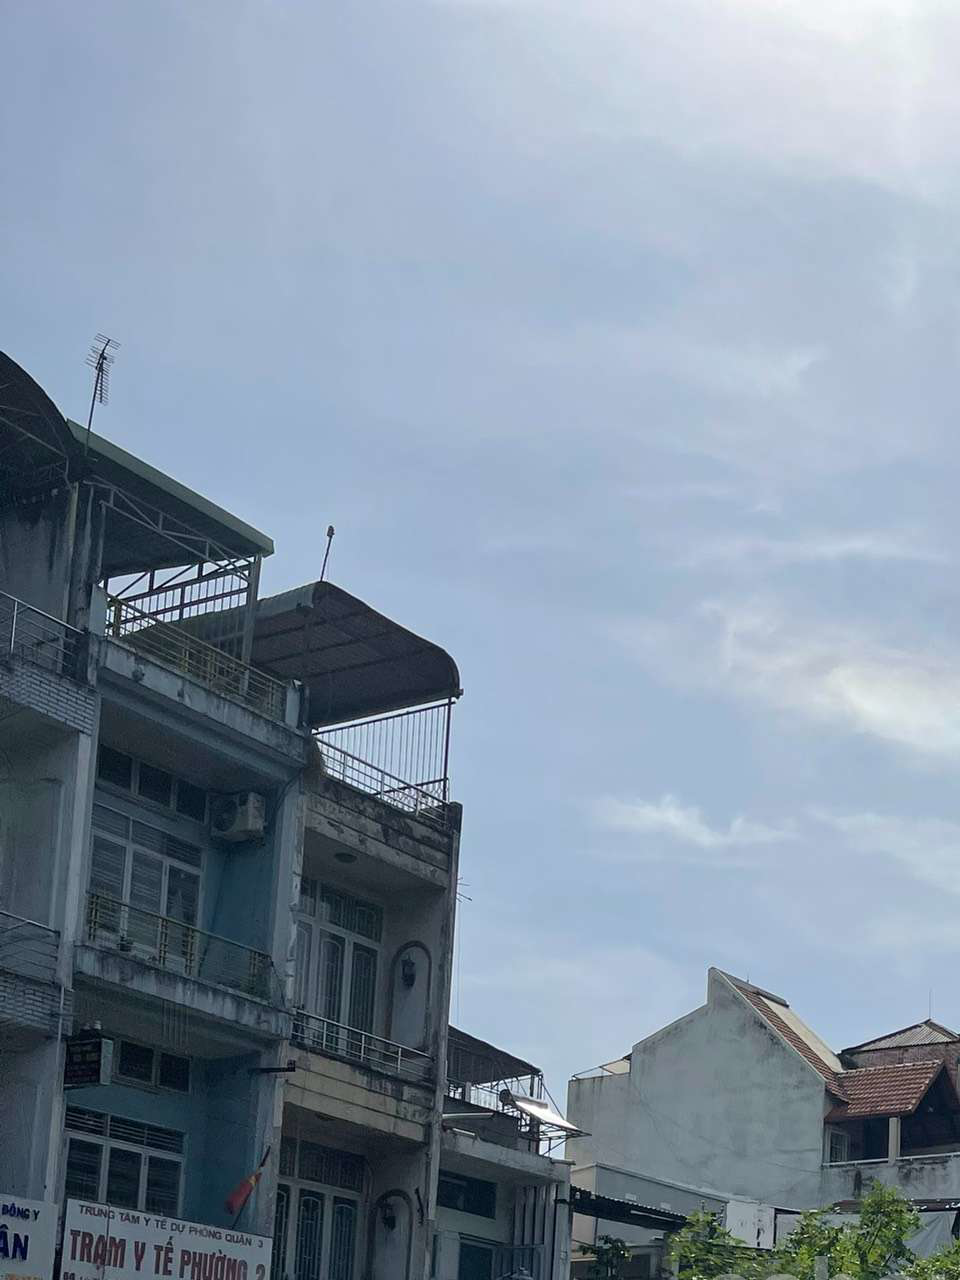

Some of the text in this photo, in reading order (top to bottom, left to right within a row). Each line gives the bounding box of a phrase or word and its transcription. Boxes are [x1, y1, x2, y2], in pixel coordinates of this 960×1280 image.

[33, 1209, 40, 1221] Y
[79, 1204, 115, 1220] TRUNG
[119, 1210, 140, 1225] TÂM
[144, 1217, 151, 1227] Y
[154, 1215, 167, 1230] TẾ
[189, 1226, 222, 1240] PHÒNG
[225, 1232, 252, 1248] QUẬN
[70, 1229, 127, 1271] TRẠM
[134, 1241, 146, 1272] Y
[154, 1236, 175, 1276] TẾ
